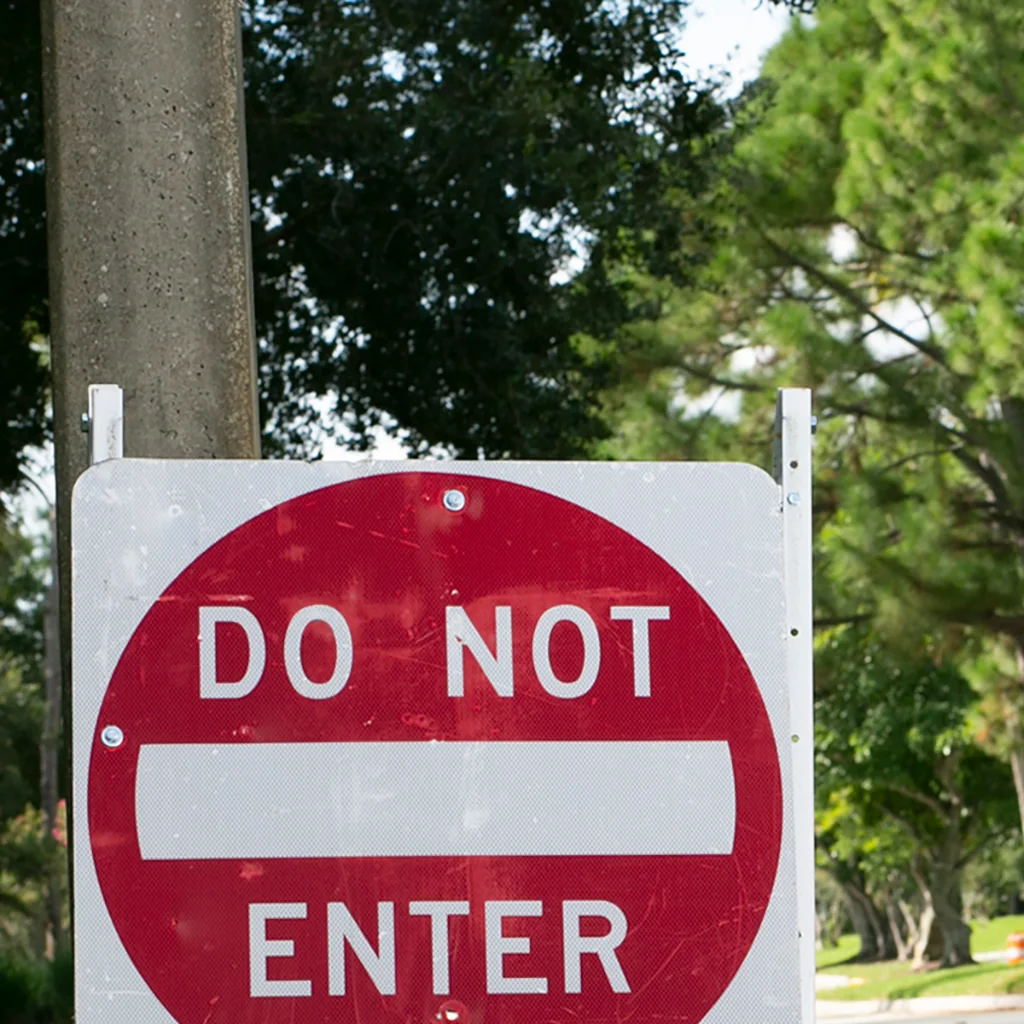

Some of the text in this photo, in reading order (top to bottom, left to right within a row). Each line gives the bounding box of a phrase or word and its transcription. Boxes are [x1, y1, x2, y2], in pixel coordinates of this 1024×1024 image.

[197, 603, 671, 700] DO NOT
[248, 899, 632, 998] ENTER
